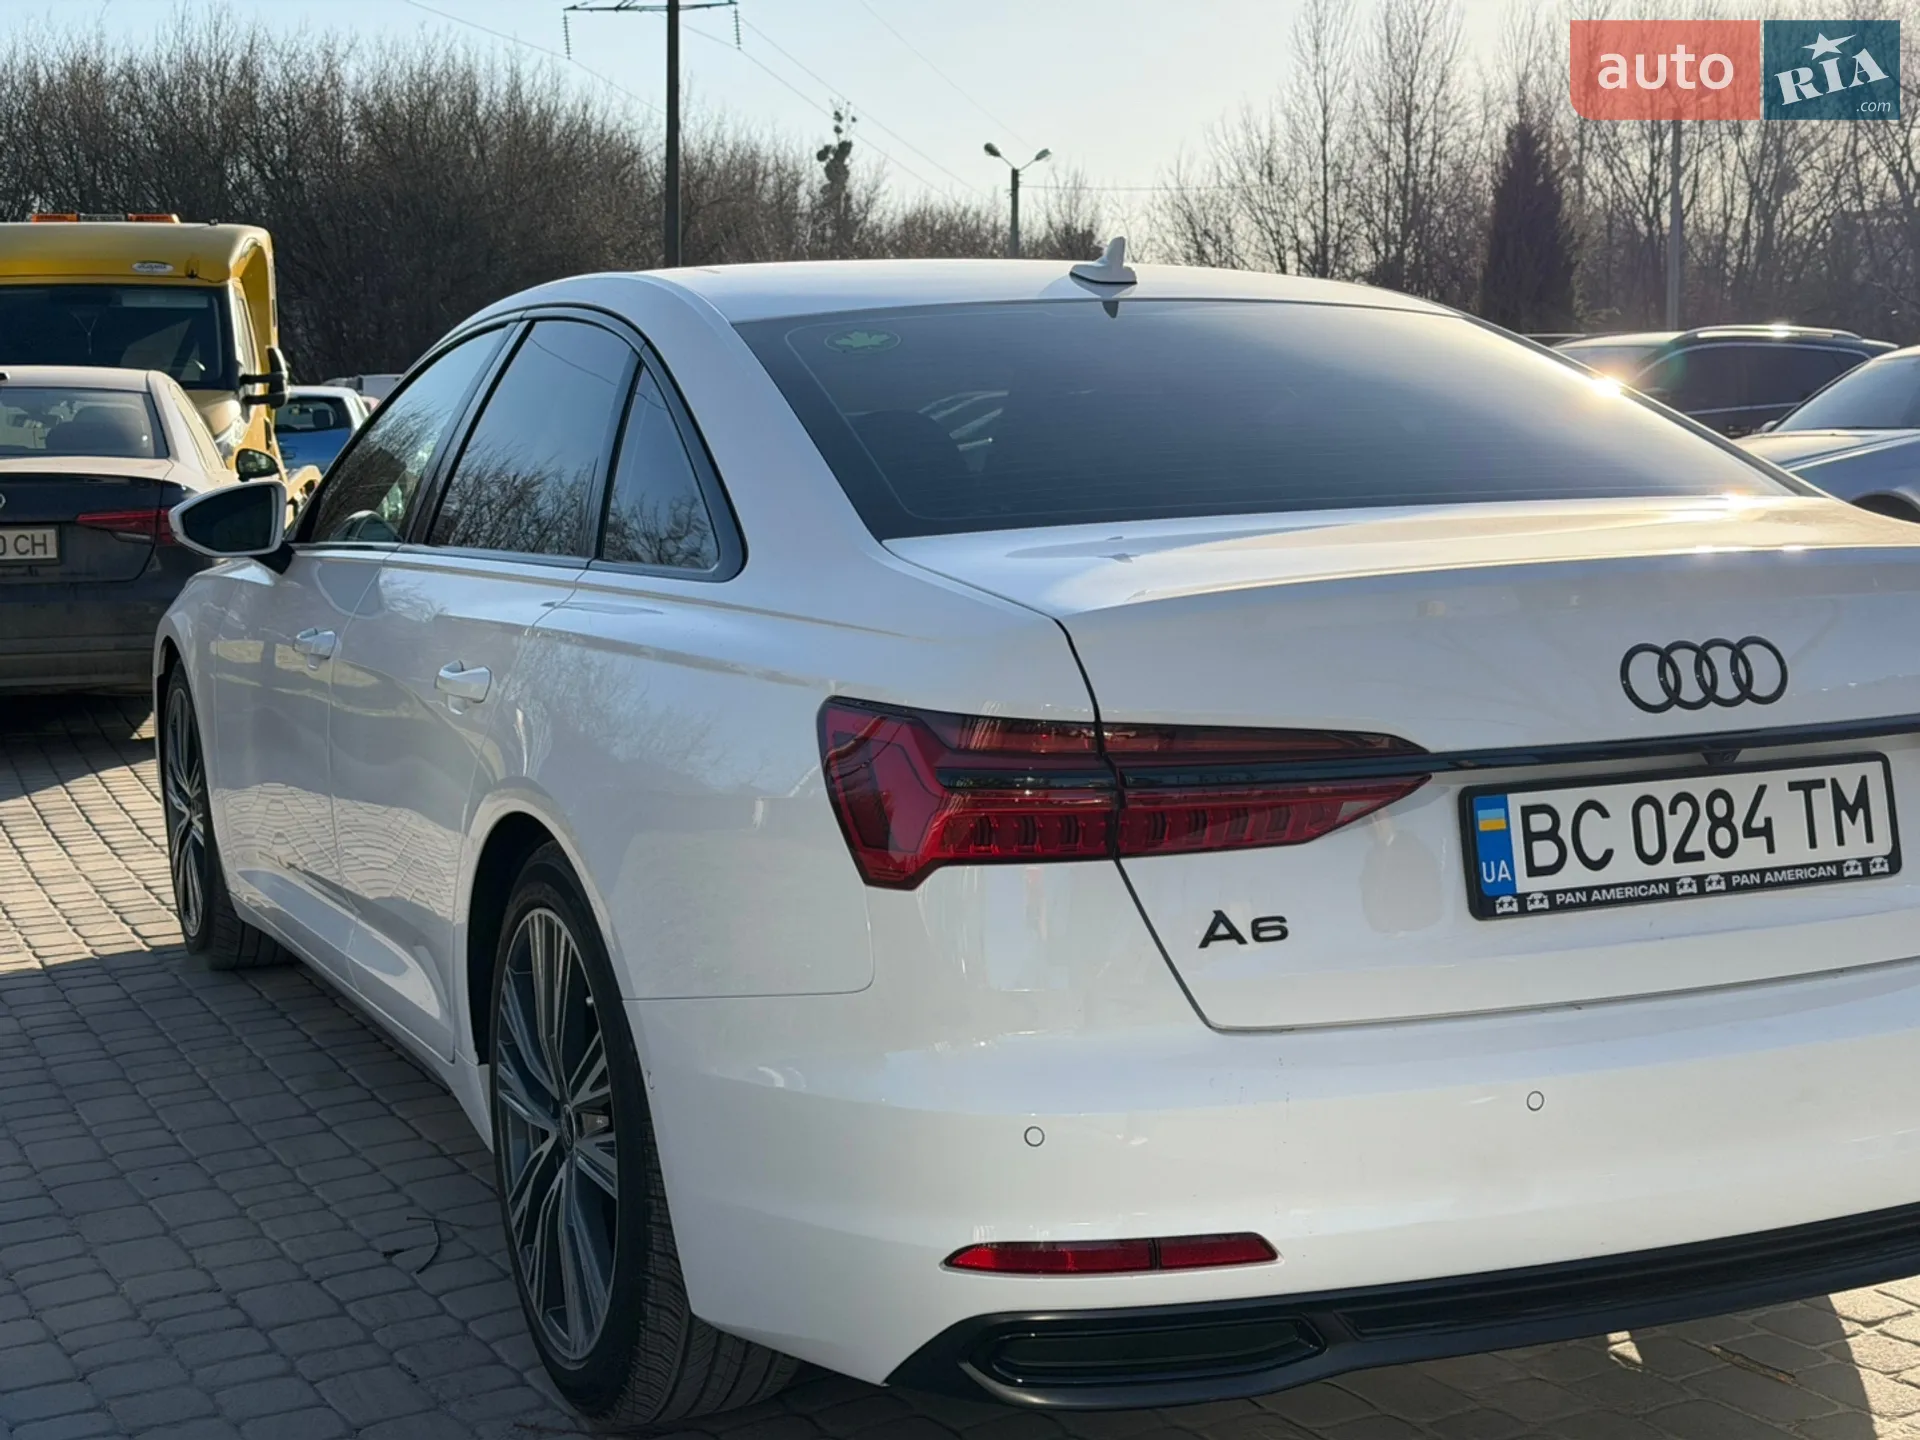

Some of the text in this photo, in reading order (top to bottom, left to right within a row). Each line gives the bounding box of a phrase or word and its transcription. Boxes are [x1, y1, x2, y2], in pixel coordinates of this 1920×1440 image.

[13, 533, 48, 556] CH
[1520, 775, 1874, 878] BC 0284 TM
[1482, 861, 1512, 883] UA
[1555, 865, 1837, 905] PAN AMERICAN PAN AMERICAN
[1198, 909, 1289, 949] A6
